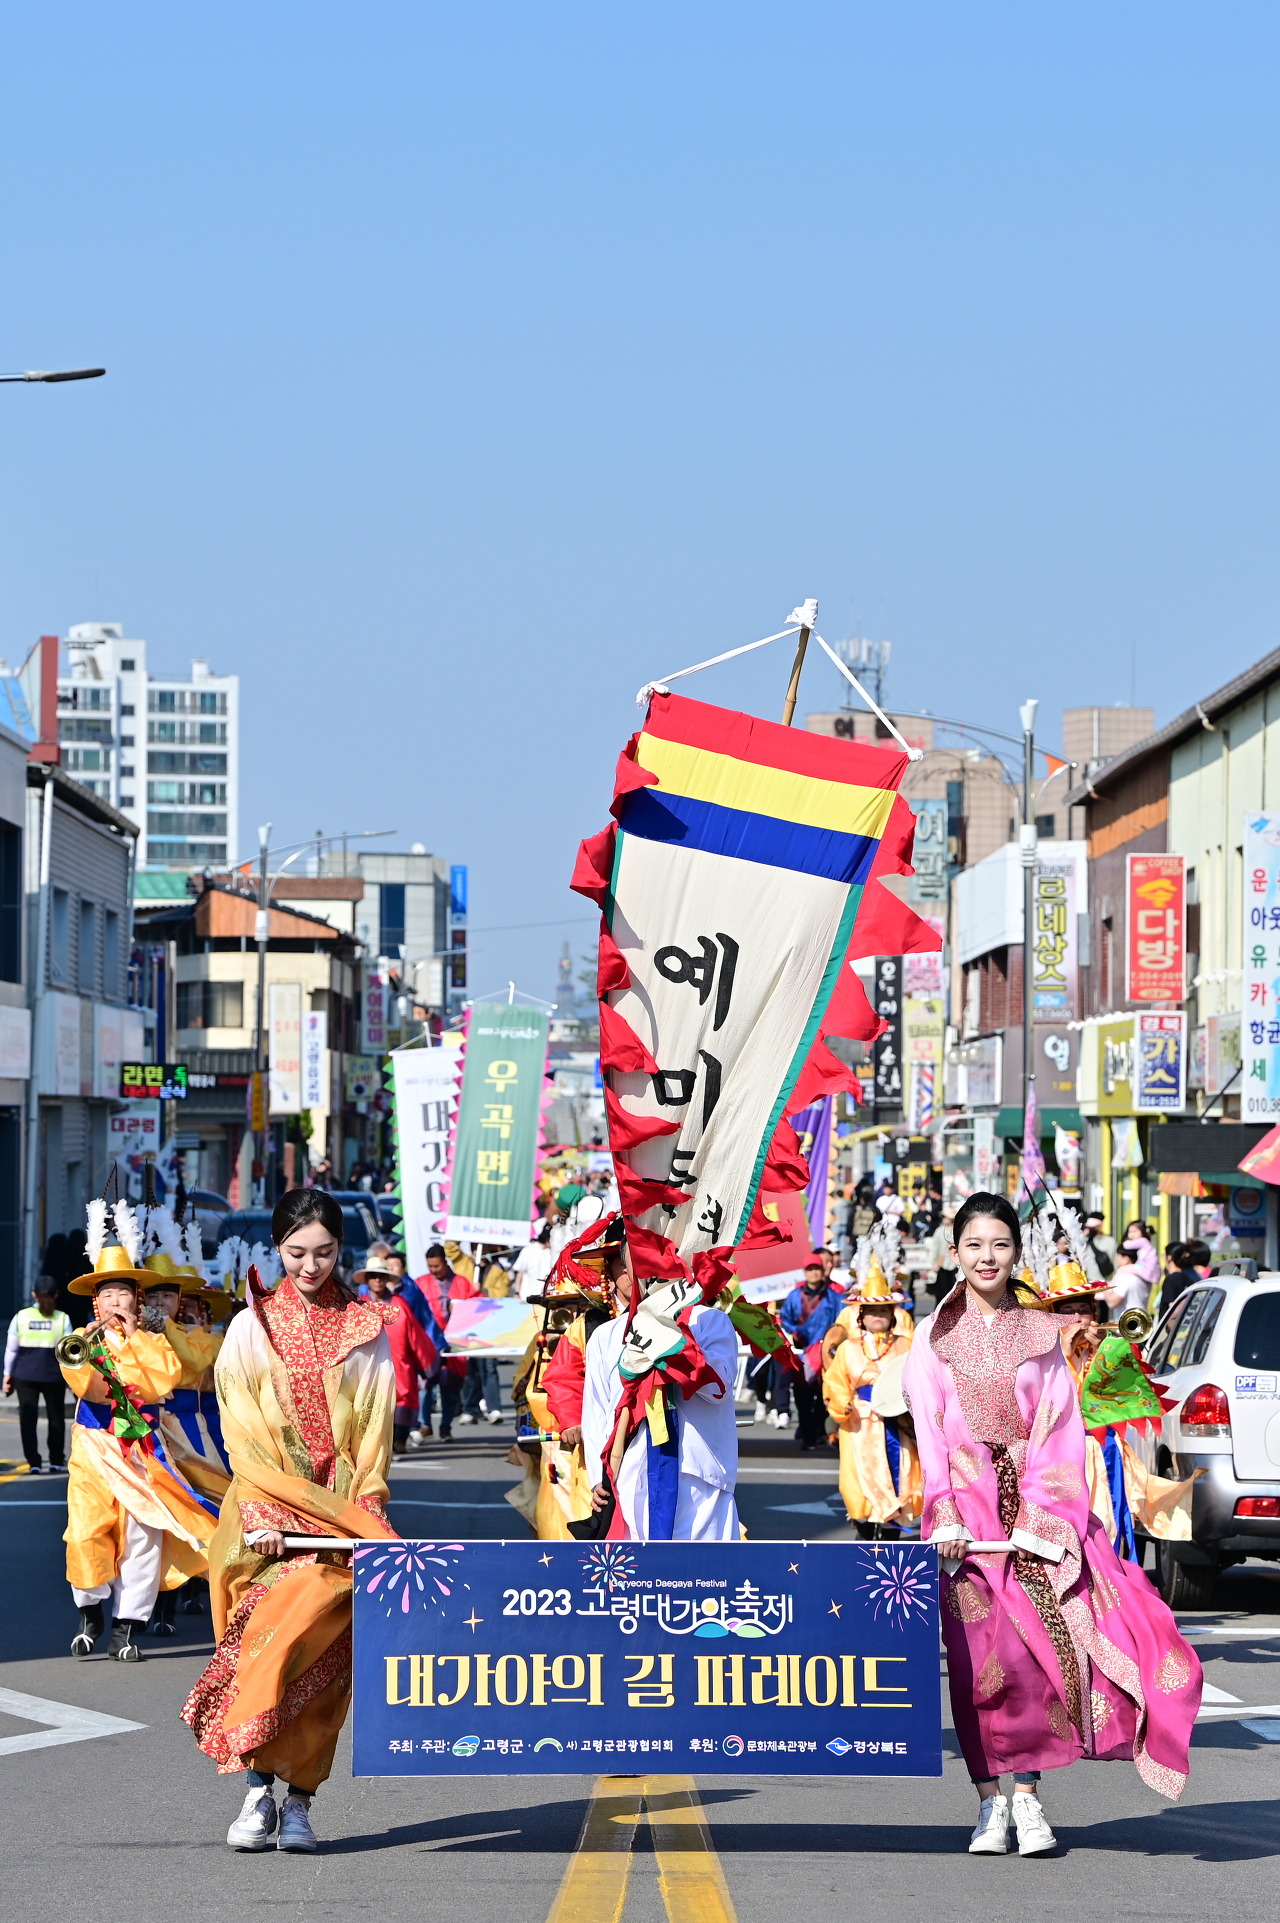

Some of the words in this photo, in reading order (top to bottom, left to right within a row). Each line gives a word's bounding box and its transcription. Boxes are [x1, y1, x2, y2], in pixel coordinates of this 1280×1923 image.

[1035, 876, 1068, 992] 르네상스
[1142, 1016, 1180, 1031] 경북
[123, 1065, 164, 1086] 라면
[1143, 1037, 1179, 1094] 가스
[111, 1117, 156, 1133] 대관령
[476, 1059, 519, 1186] 우곡면
[1236, 1376, 1256, 1387] DPF
[655, 1579, 693, 1589] Daegaya
[695, 1579, 727, 1588] Festival
[502, 1588, 572, 1616] 2023
[575, 1579, 793, 1635] 고령대가야축제
[383, 1653, 605, 1707] 대가야의
[622, 1653, 675, 1708] 길
[693, 1654, 913, 1708] 퍼레이드
[481, 1739, 524, 1755] 고령군
[580, 1740, 674, 1752] 고령군관광협의회
[689, 1738, 718, 1753] 후원:
[746, 1740, 817, 1753] 문화체육관광부
[853, 1740, 908, 1755] 경상북도
